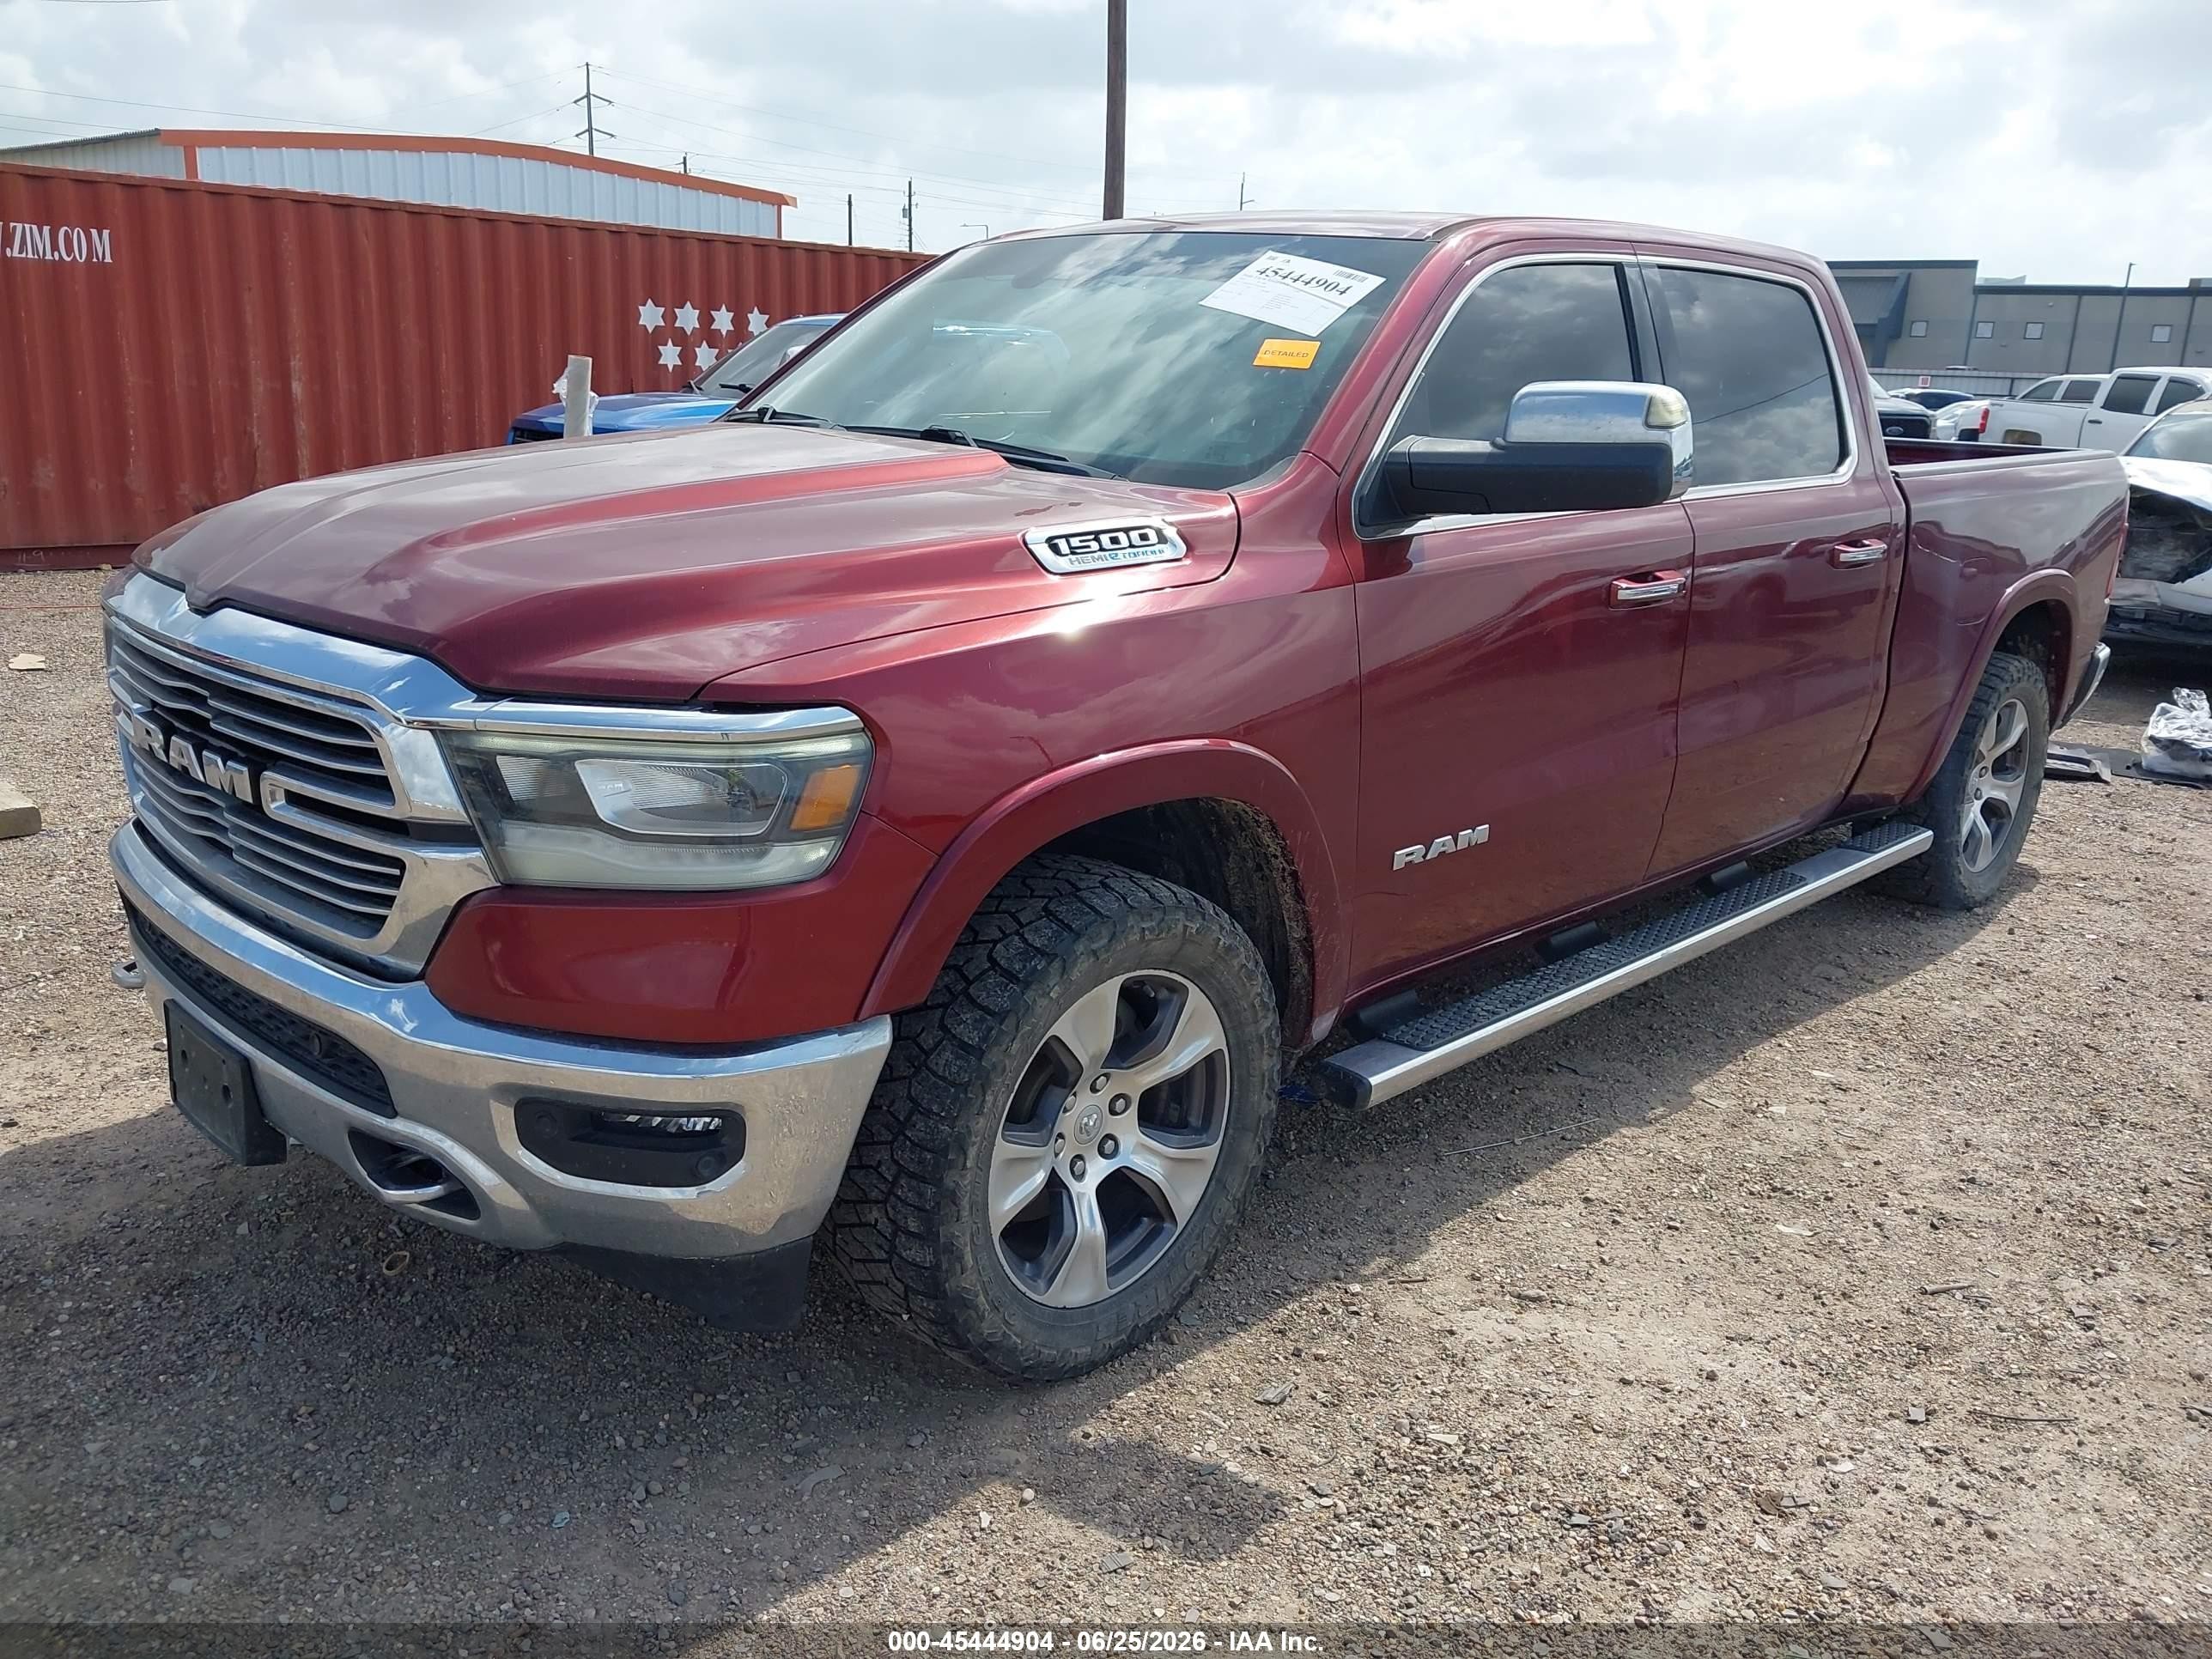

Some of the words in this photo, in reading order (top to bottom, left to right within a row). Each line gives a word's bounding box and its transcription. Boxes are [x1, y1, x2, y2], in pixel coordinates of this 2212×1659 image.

[1256, 265, 1353, 296] 45444904
[1263, 349, 1310, 358] DETAILED
[1050, 526, 1159, 556] 1500
[1068, 554, 1109, 565] HEMI
[132, 711, 254, 804] RAM
[1392, 823, 1490, 871] RAM
